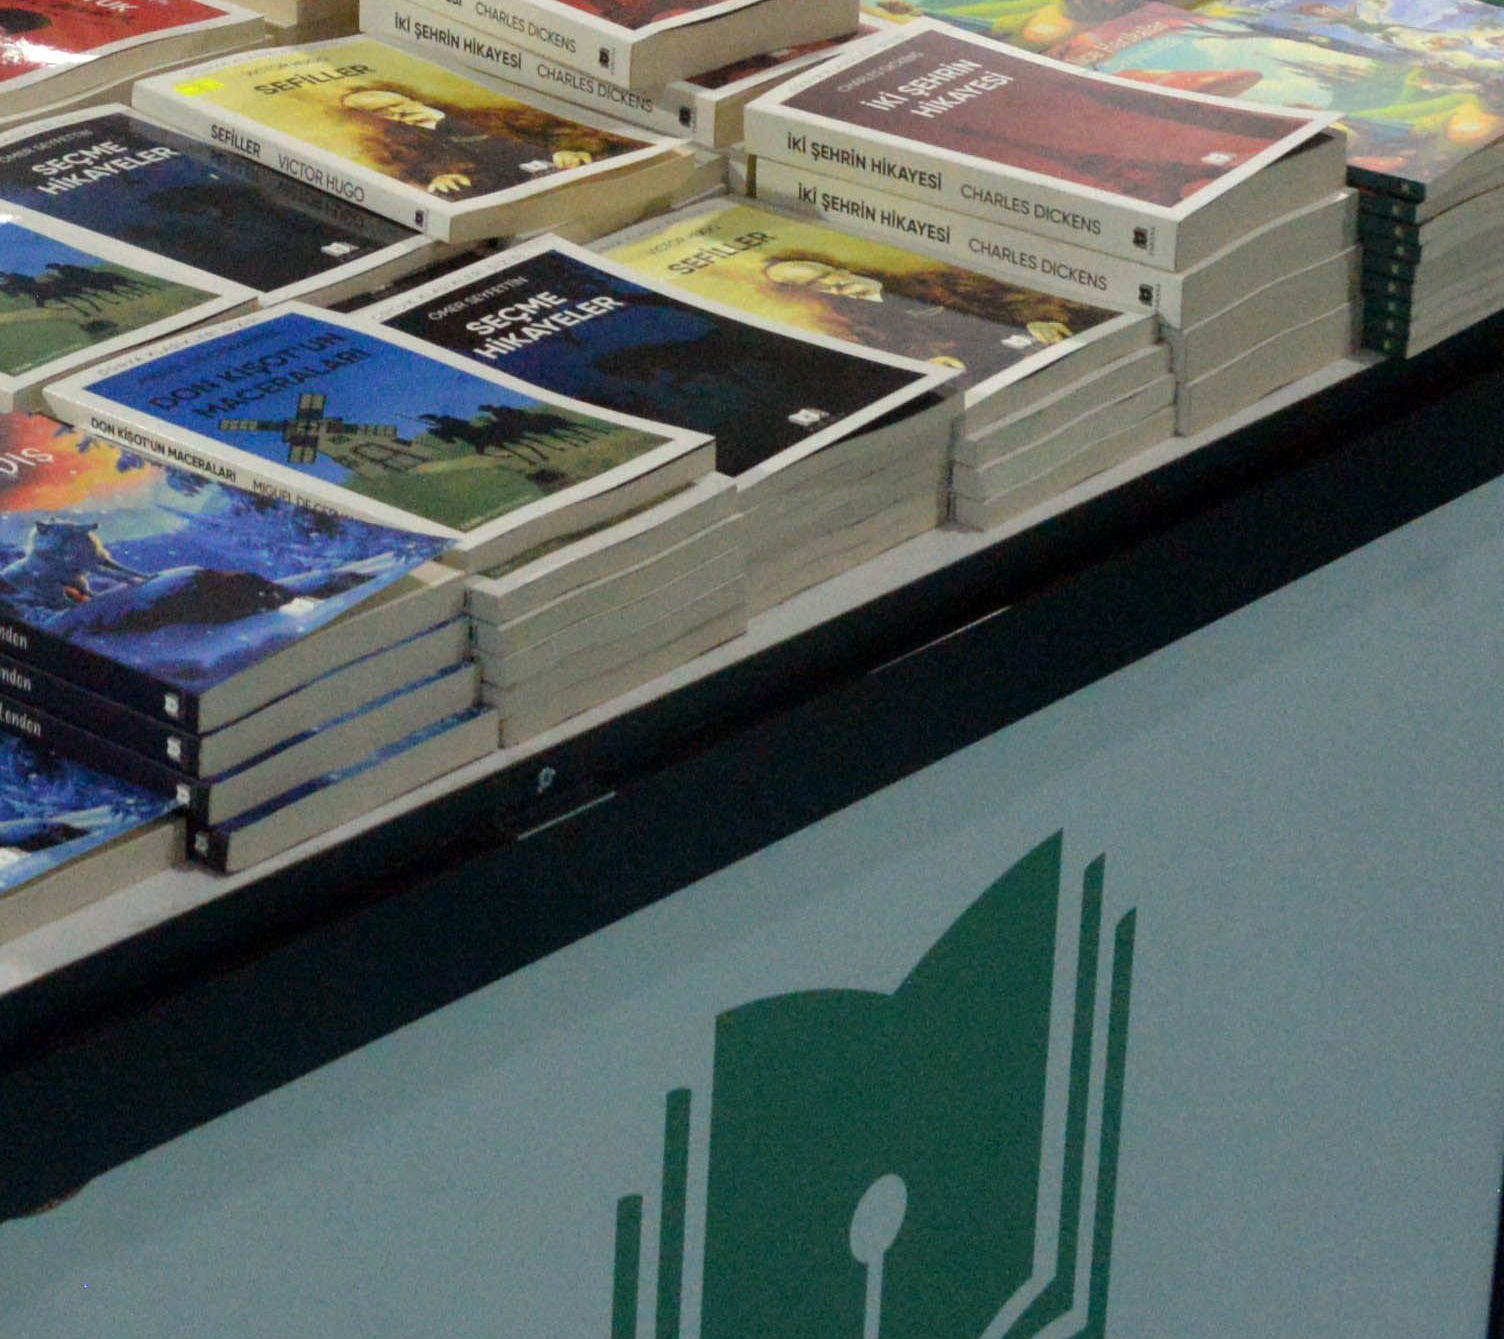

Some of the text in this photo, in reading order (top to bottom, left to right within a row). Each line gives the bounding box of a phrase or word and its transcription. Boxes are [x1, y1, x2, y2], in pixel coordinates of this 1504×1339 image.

[475, 0, 526, 36] CHARLES
[528, 23, 577, 54] DICKENS
[253, 62, 376, 97] SEFİLLER
[394, 11, 653, 114] İKİ ŞEHRİN HİKAYESİ CHARLES DICKENS
[859, 56, 984, 112] İKİ ŞEHRİN
[910, 71, 1015, 120] HİKAYESİ
[31, 139, 130, 177] SEÇME
[36, 145, 182, 197] HİKAYELER
[211, 123, 366, 204] SEFİLLER VICTOR HUGO
[787, 132, 1102, 236] İKİ ŞEHRİN HİKAYESİ CHARLES DICKENS
[667, 229, 777, 277] SEFİLLER
[797, 181, 1108, 293] İKİ ŞEHRİN HİKAYESİ CHARLES DICKENS
[465, 290, 569, 337] SEÇME
[471, 295, 628, 360] HİKAYELER
[149, 379, 217, 412] DON
[193, 347, 373, 420] MACERALARI
[91, 417, 117, 438] DON
[167, 443, 238, 482] MACERALARI
